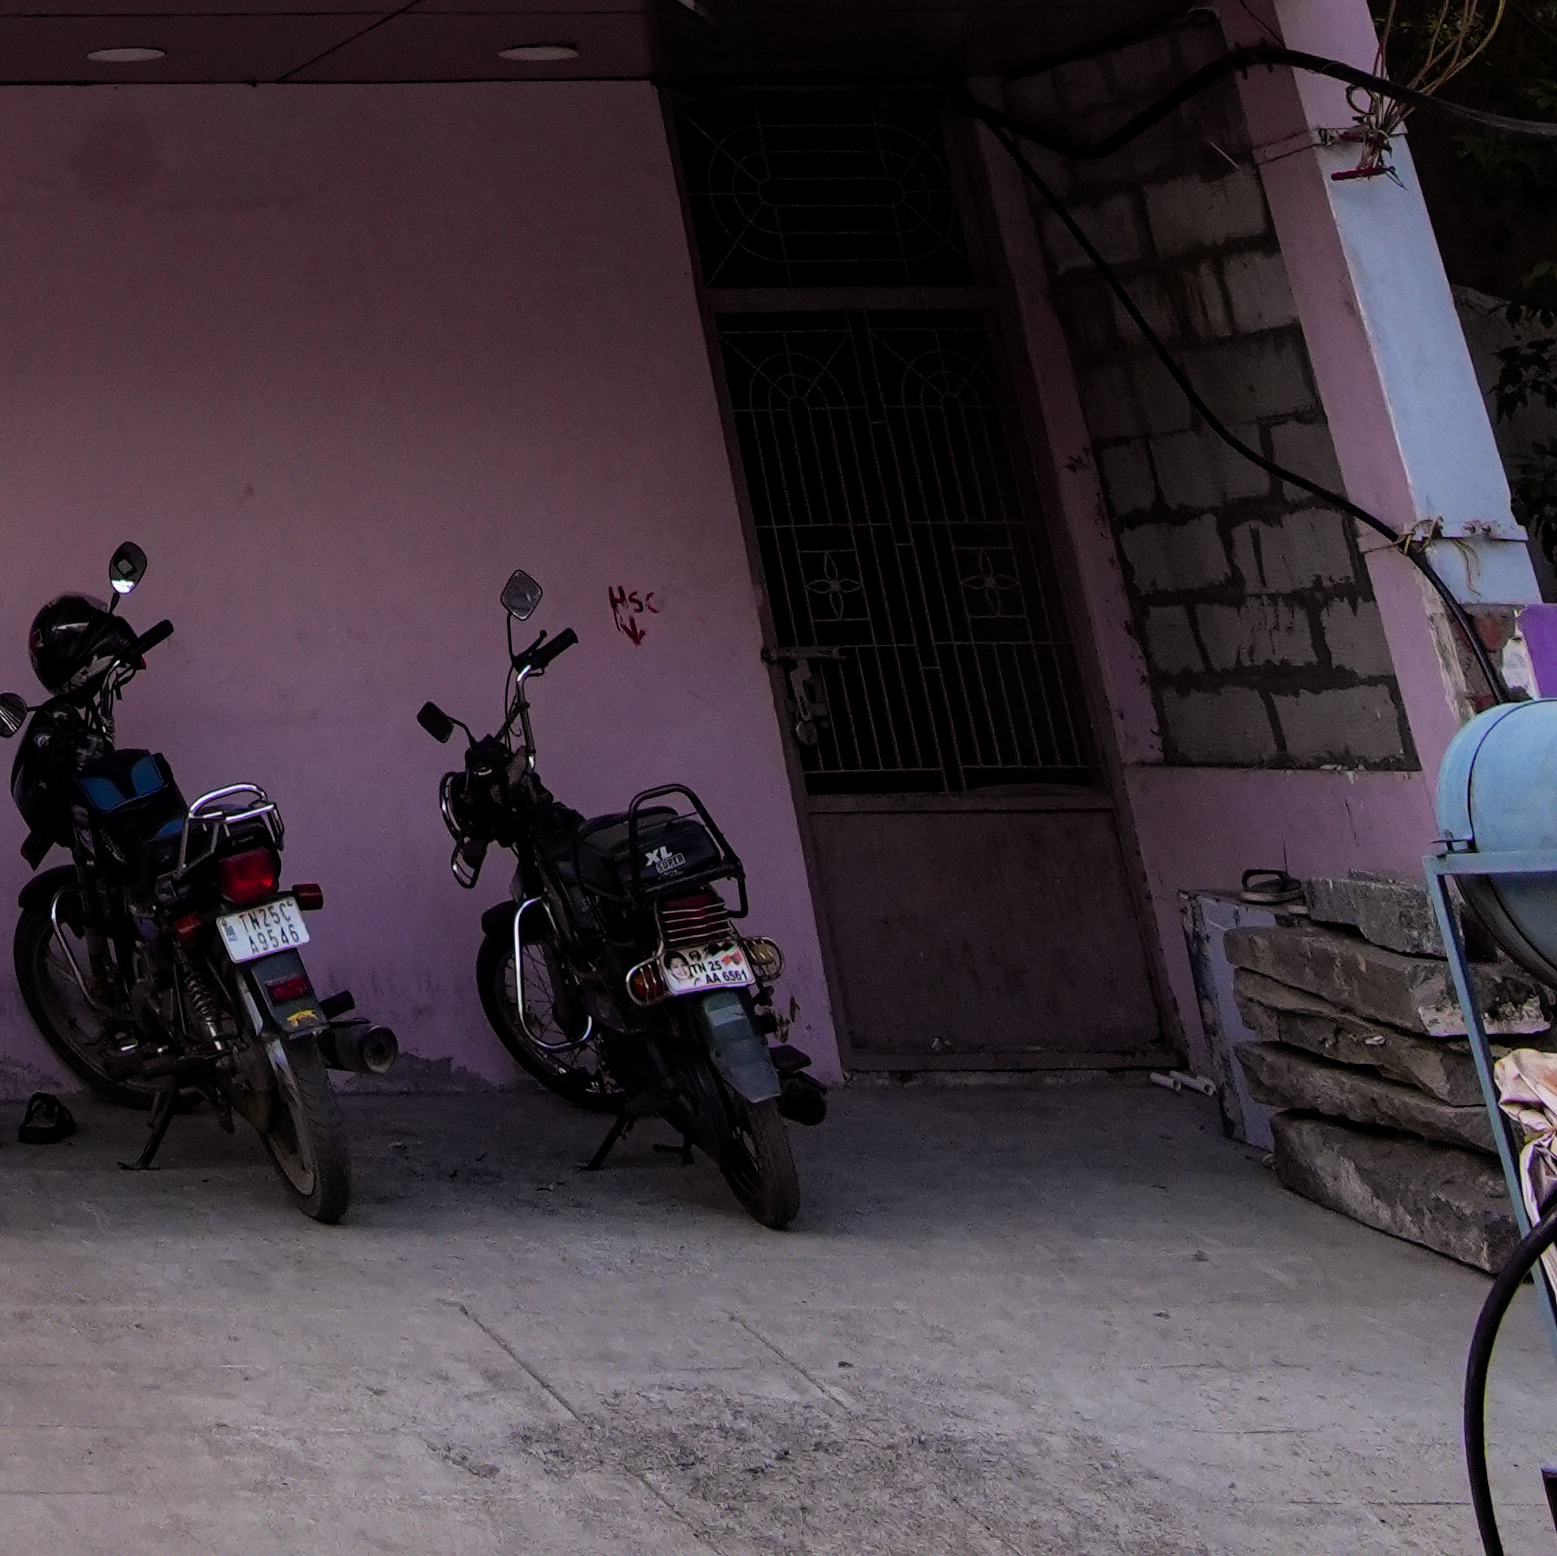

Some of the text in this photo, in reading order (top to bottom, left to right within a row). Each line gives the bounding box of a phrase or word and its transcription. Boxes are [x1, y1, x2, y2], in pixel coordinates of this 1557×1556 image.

[645, 846, 673, 867] XL
[657, 854, 684, 873] SUPER
[689, 961, 722, 978] TN 25
[705, 973, 720, 985] AA
